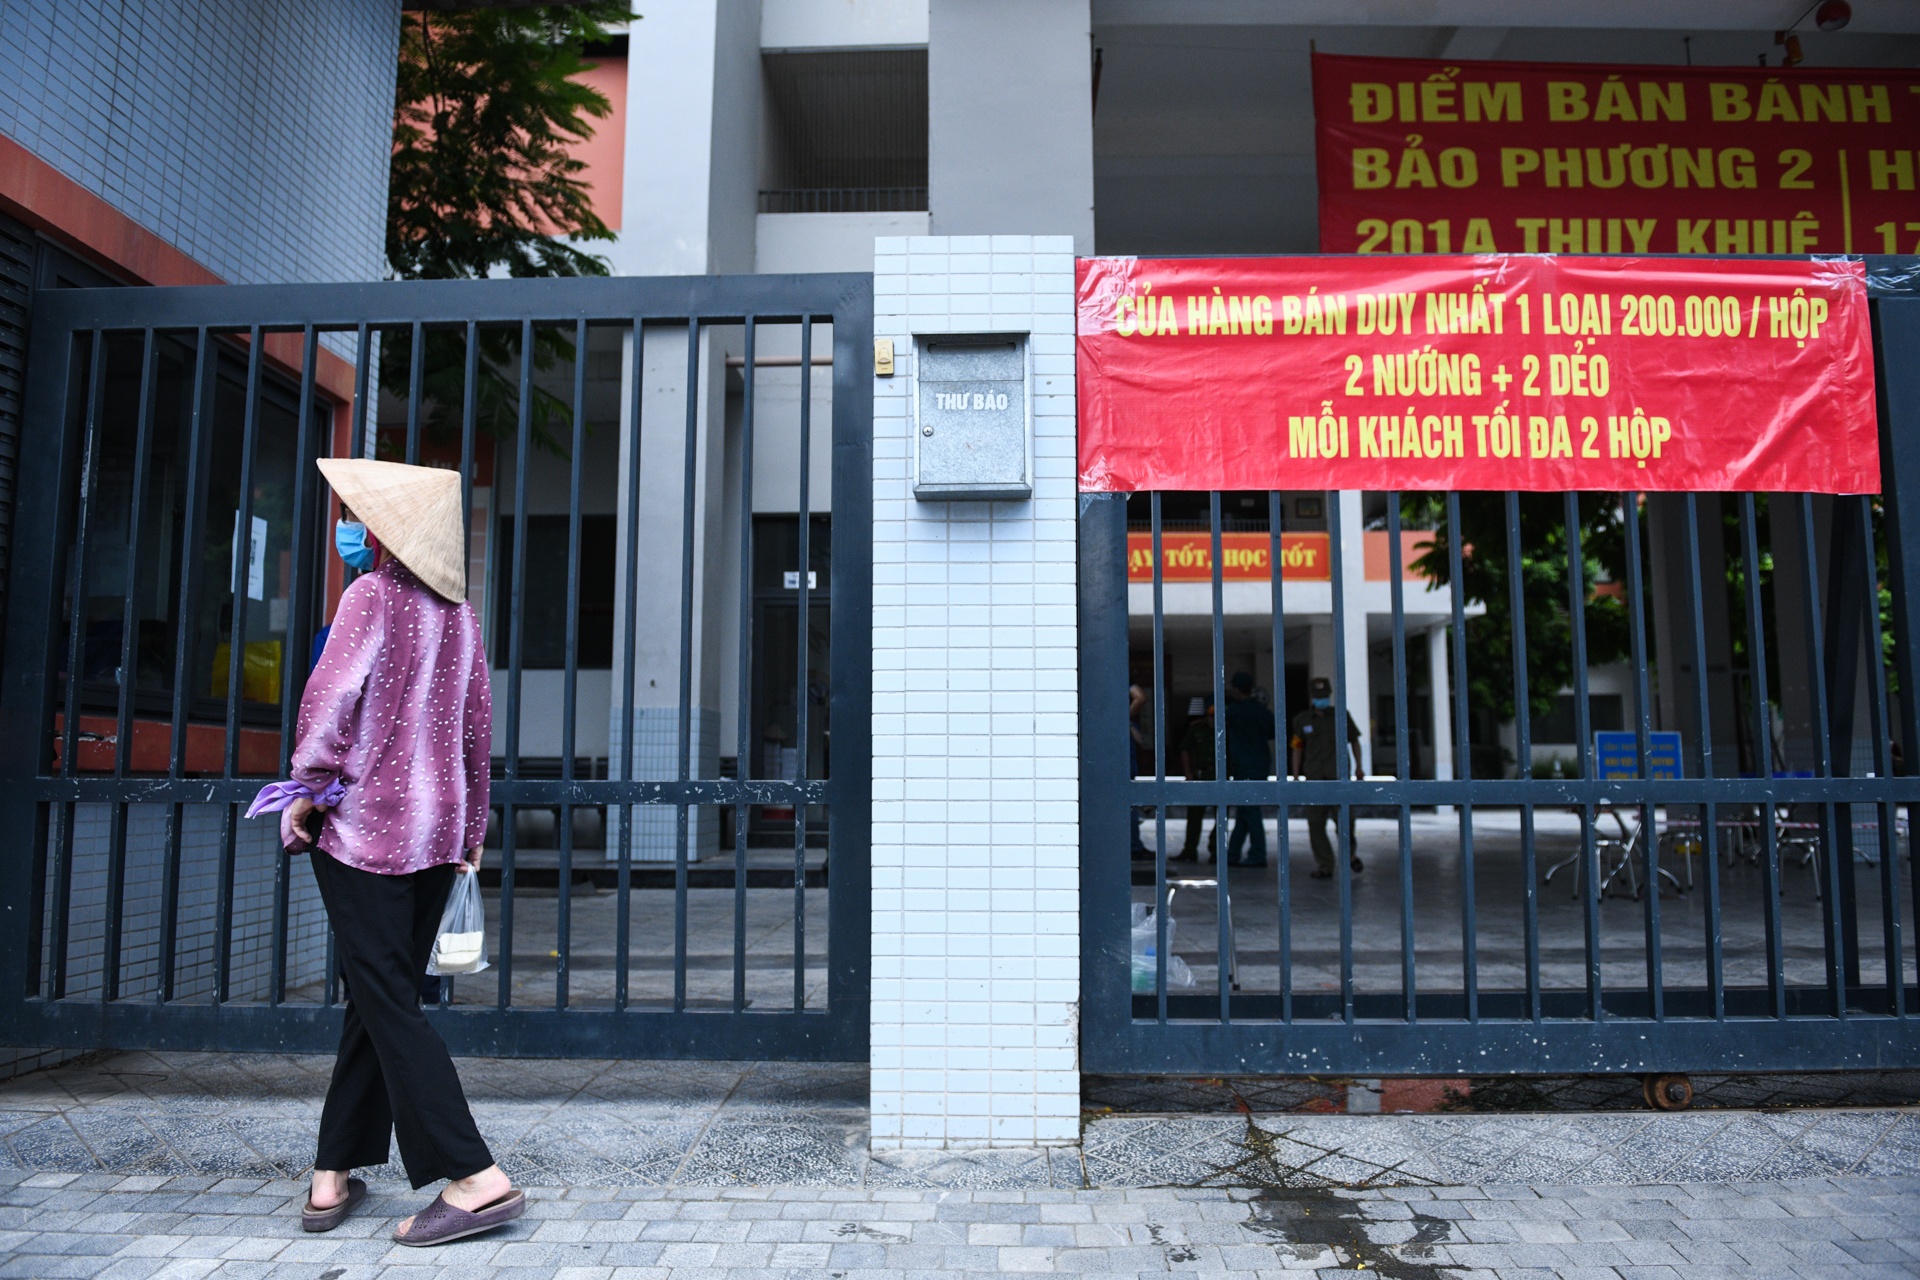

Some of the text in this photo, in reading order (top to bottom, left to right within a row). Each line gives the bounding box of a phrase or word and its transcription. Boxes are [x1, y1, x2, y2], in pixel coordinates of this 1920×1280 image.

[1349, 66, 1892, 123] ĐIỂM BÁN BÁNH
[1352, 134, 1815, 189] BẢO PHƯƠNG 2
[1869, 149, 1920, 191] H
[1356, 218, 1498, 254] 201A
[1677, 211, 1820, 254] KHUÊ
[1188, 287, 1273, 335] HÀNG
[1283, 287, 1347, 335] BÁN
[1357, 293, 1416, 334] DUY
[1426, 277, 1507, 334] NHẤT
[1516, 293, 1530, 334] 1
[1543, 293, 1611, 345] LOẠI
[1621, 294, 1741, 338] 200.000
[1769, 287, 1828, 348] HỘP
[1345, 354, 1364, 396] 2
[1373, 344, 1482, 396] NƯỚNG
[1522, 354, 1541, 396] 2
[1549, 340, 1610, 397] DẺO
[935, 389, 1008, 410] THƯ BÁO
[1288, 399, 1671, 468] MỖI KHÁCH TỐI ĐA 2 HỘP
[1127, 549, 1153, 573] ẠY
[1222, 549, 1268, 572] HỌC
